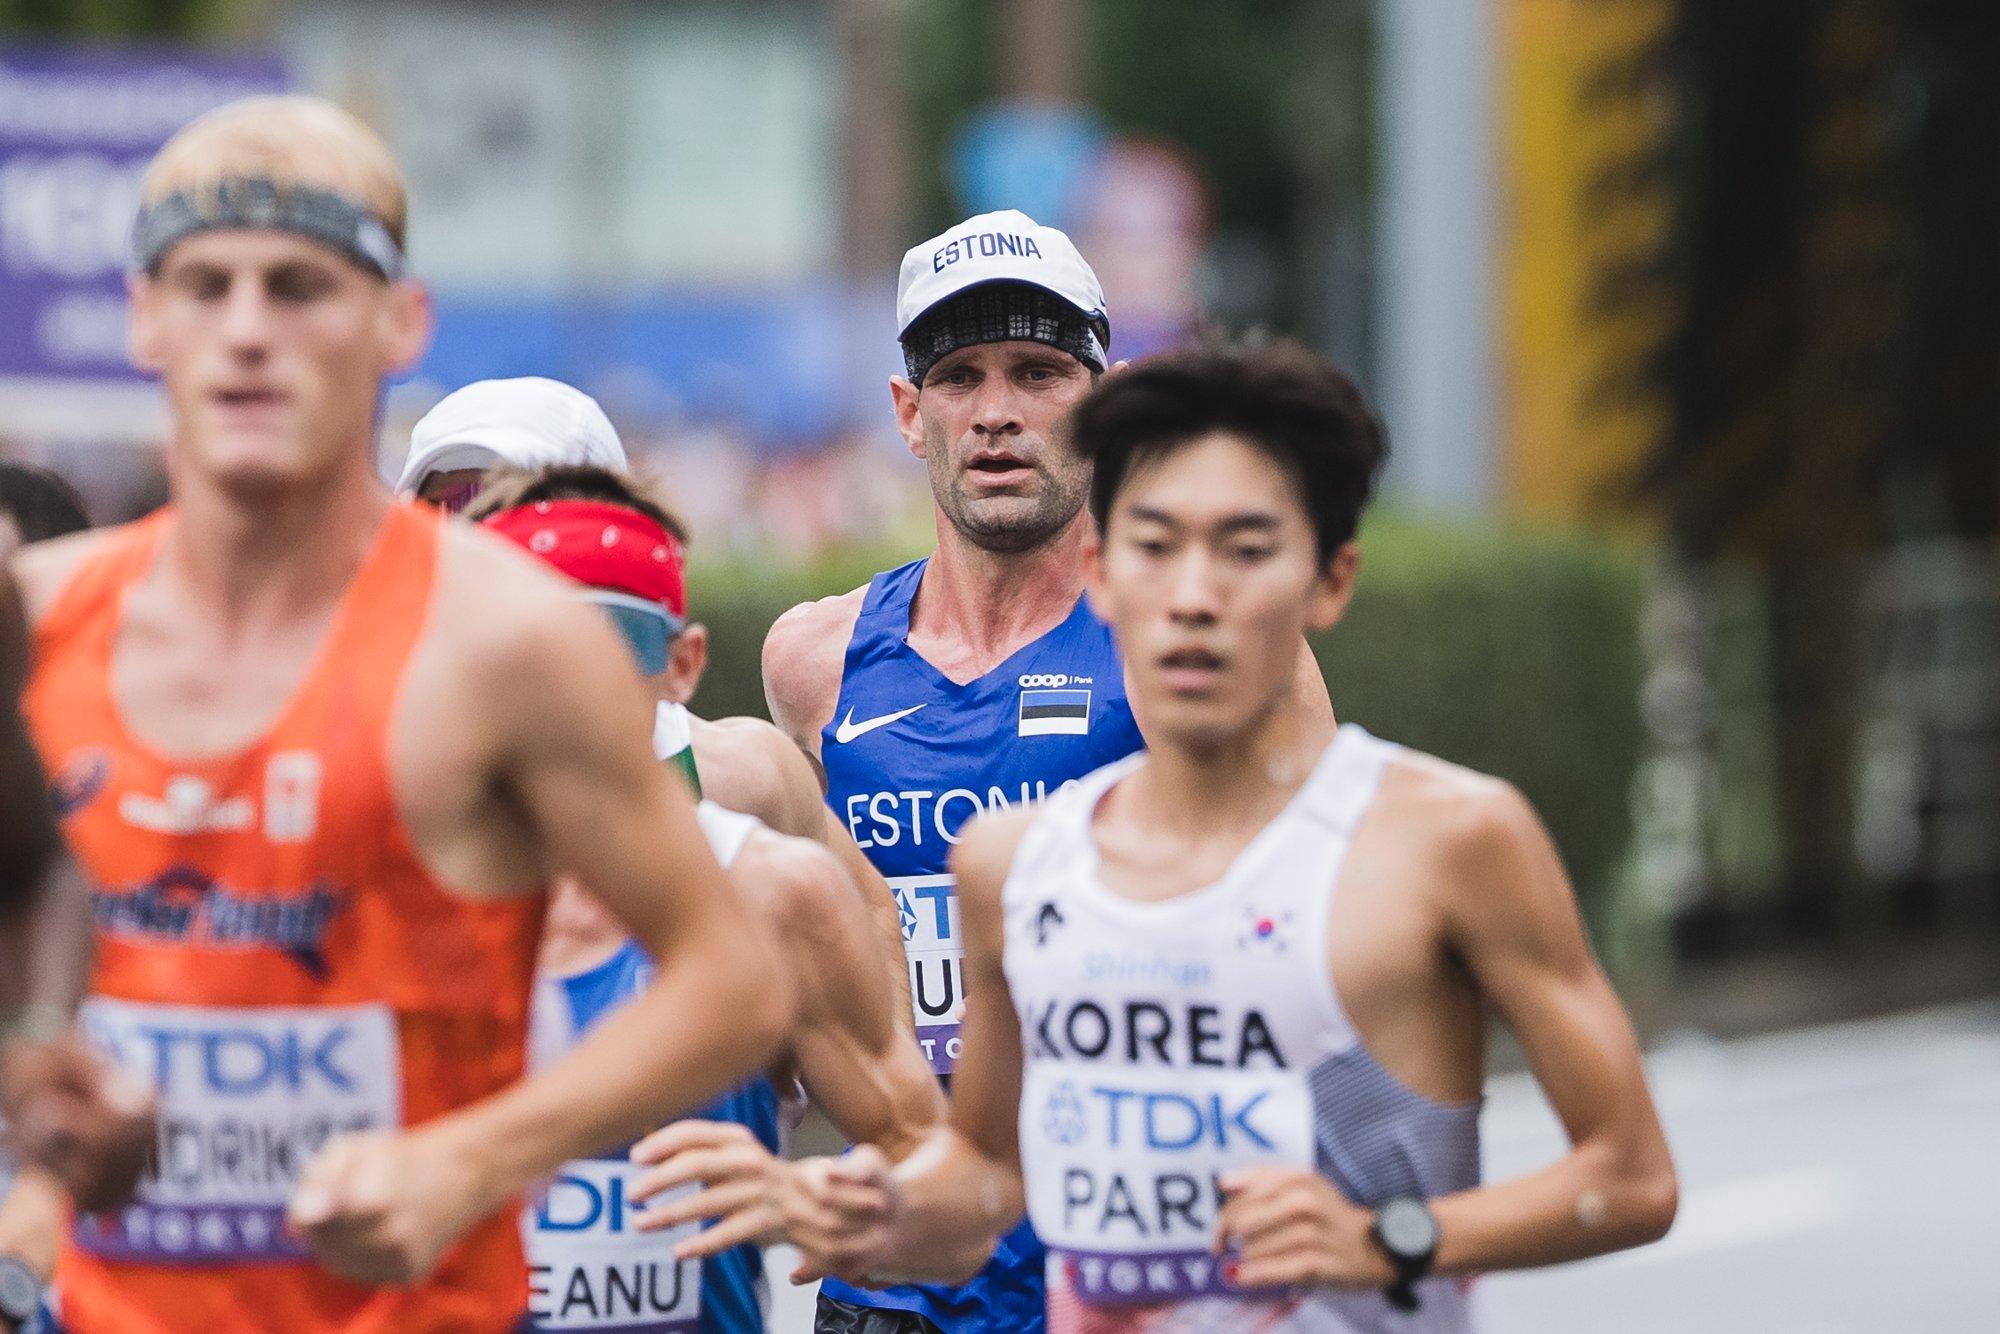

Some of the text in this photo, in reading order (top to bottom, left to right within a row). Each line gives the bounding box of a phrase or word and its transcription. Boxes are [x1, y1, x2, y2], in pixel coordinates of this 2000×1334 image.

[933, 232, 1042, 274] ESTONIA
[138, 1026, 355, 1093] TDK
[1027, 1001, 1287, 1070] KOREA
[1092, 1087, 1275, 1150] TDK
[1079, 1256, 1213, 1293] TOKY
